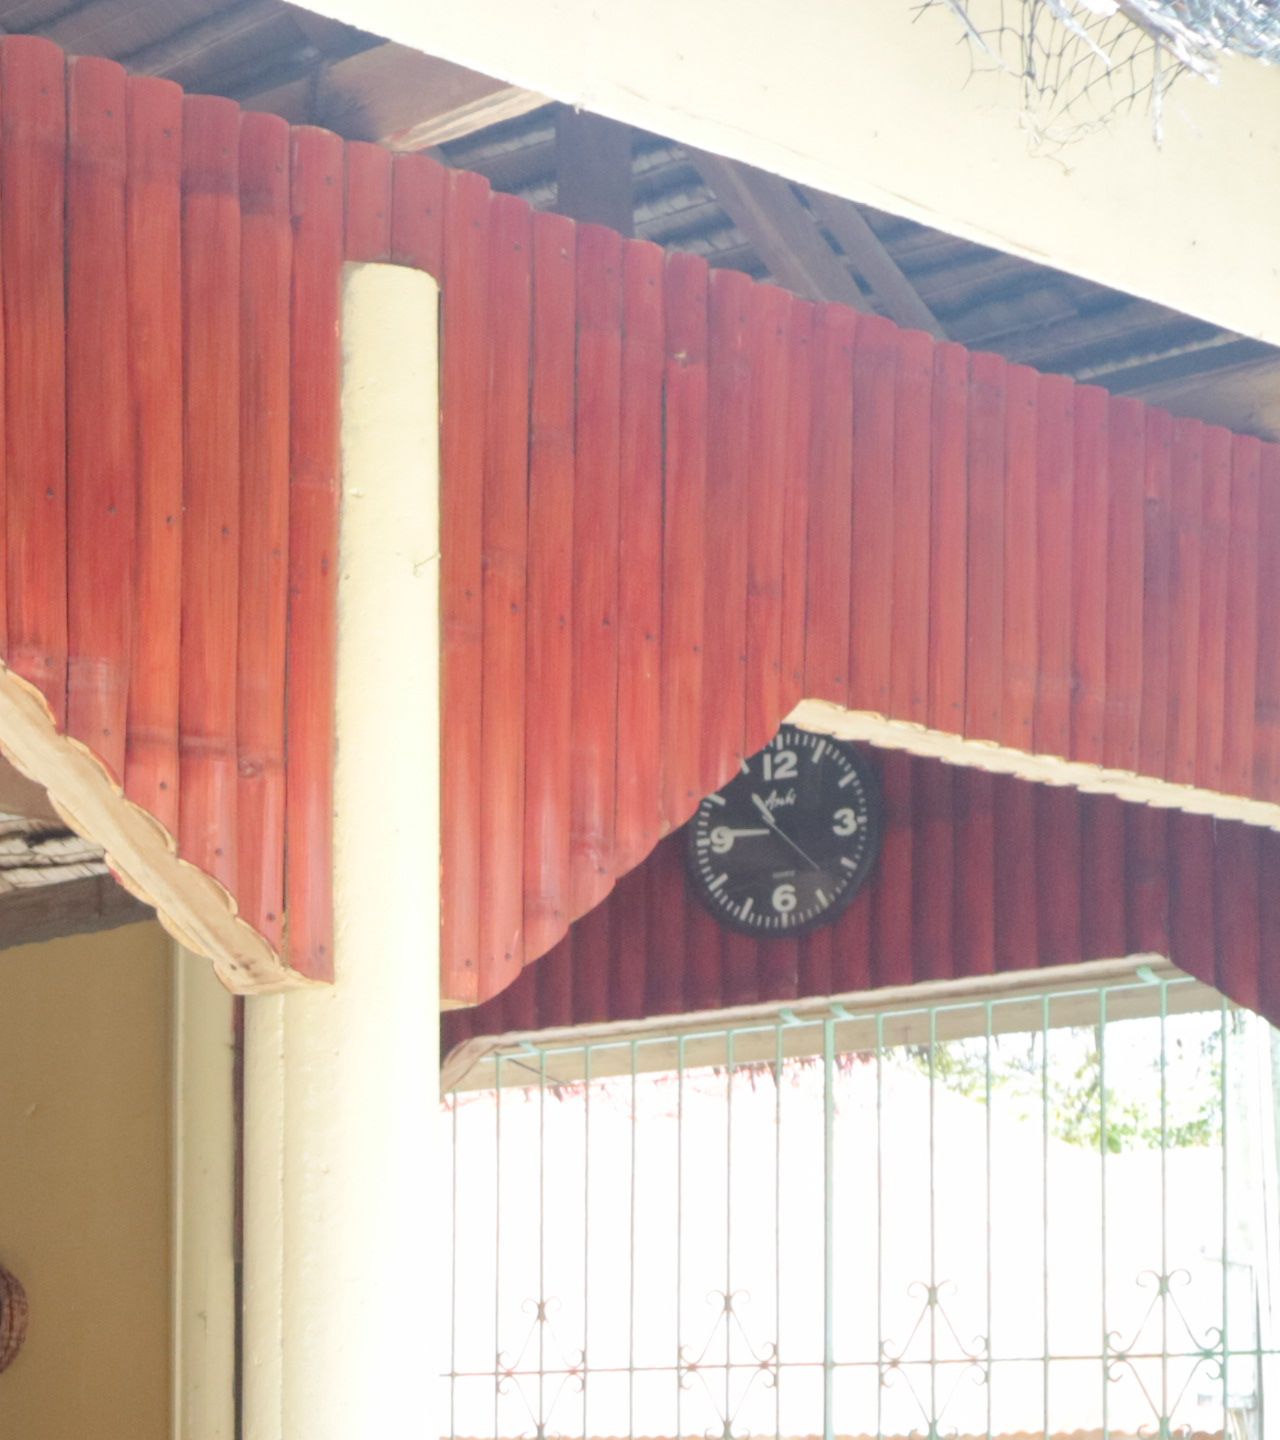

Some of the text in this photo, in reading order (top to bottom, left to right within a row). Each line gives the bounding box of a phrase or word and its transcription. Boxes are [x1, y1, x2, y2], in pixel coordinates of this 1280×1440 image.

[763, 751, 798, 781] 12
[832, 808, 858, 836] 3
[710, 826, 735, 854] 9
[771, 884, 797, 912] 6
